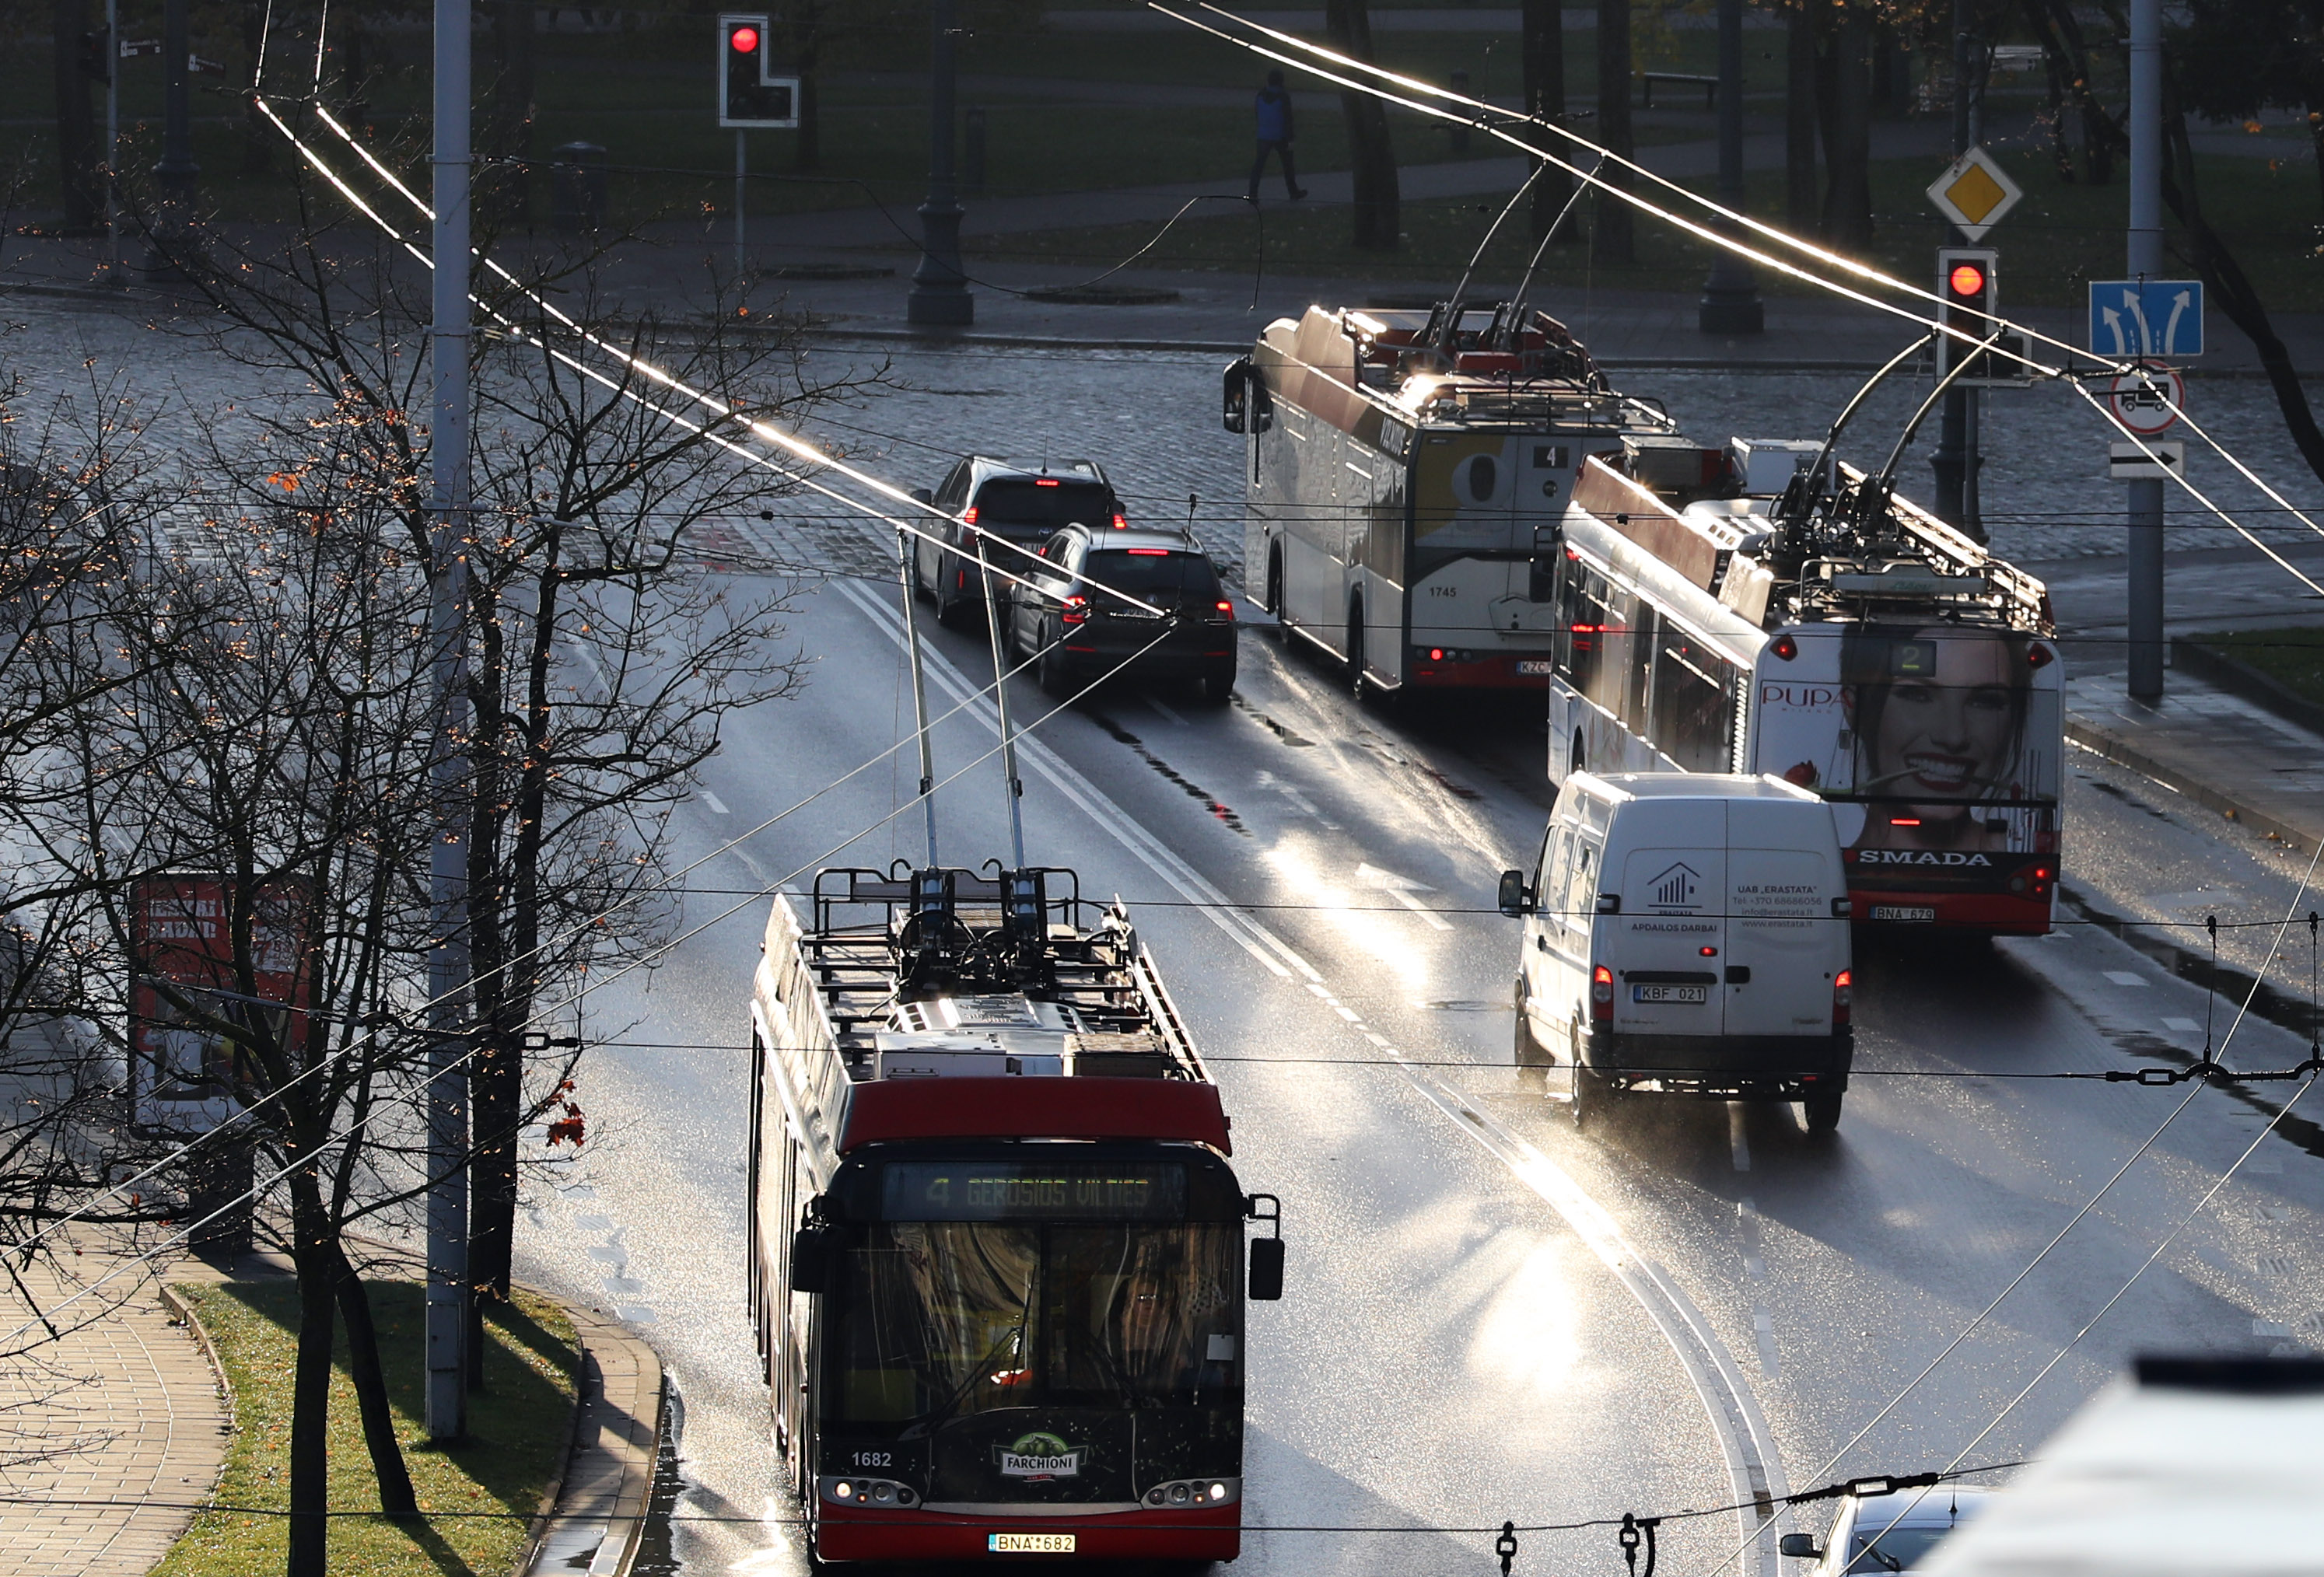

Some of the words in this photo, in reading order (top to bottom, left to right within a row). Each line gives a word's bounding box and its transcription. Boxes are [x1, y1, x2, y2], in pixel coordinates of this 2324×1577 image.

[1547, 446, 1556, 467] 4
[1430, 587, 1456, 597] 1745
[1902, 646, 1920, 670] 2
[1762, 686, 1854, 710] PUPA
[1860, 850, 1992, 866] SMADA
[1877, 908, 1902, 919] BNA
[1632, 923, 1679, 932] APDAILOS
[1681, 924, 1717, 932] DARBAI
[1643, 988, 1670, 999] KBF
[1679, 988, 1703, 1000] 021
[926, 1178, 949, 1208] 4
[852, 1451, 892, 1467] 1682
[1008, 1457, 1072, 1469] FARCHIONI
[999, 1536, 1031, 1550] BNA
[1044, 1537, 1072, 1551] 682
